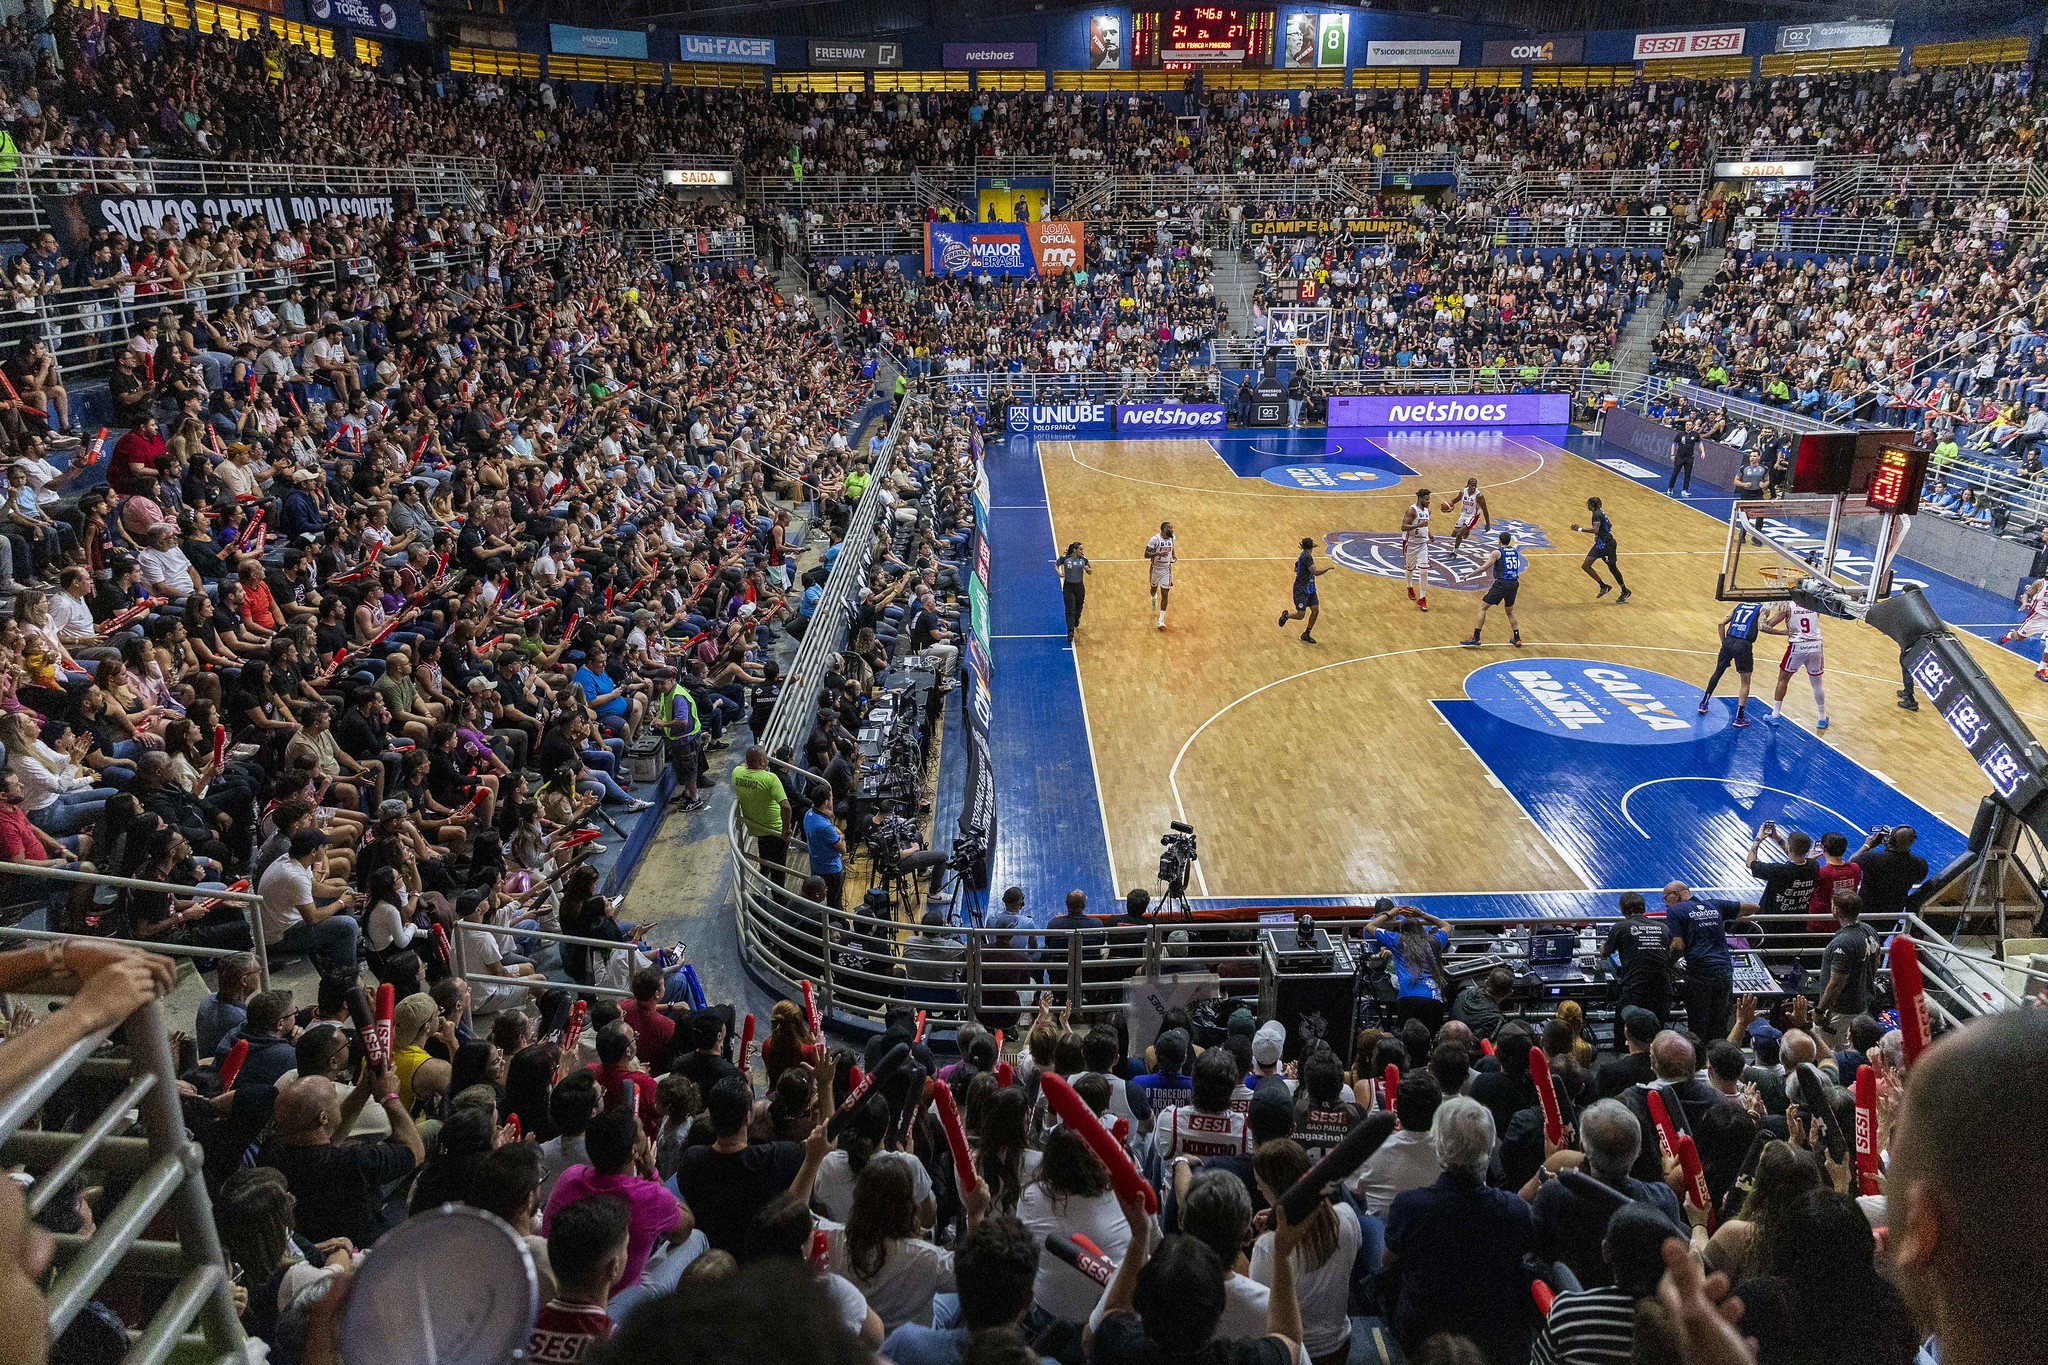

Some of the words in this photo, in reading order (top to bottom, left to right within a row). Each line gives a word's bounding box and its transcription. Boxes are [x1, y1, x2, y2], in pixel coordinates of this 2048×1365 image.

[335, 2, 369, 18] TORCE
[1174, 11, 1181, 20] 2
[1194, 8, 1222, 19] 7:46.8
[1231, 11, 1237, 19] 4
[1172, 25, 1187, 37] 24
[1228, 25, 1243, 37] 27
[1790, 32, 1803, 40] Q2
[1327, 30, 1340, 49] 8
[1643, 39, 1681, 53] SESI
[1695, 36, 1736, 50] SESI
[815, 47, 866, 58] FREEWAY
[966, 50, 1015, 60] netshoes
[101, 199, 198, 242] SOMOS
[1042, 224, 1070, 234] LOJA
[1040, 236, 1075, 244] OFICIAL
[973, 244, 1020, 256] MAIOR
[972, 259, 981, 267] do
[983, 256, 1024, 267] BRASIL
[1033, 405, 1105, 423] UNIUBE
[1123, 407, 1223, 426] netshoes
[1388, 401, 1507, 422] netshoes
[1505, 556, 1518, 570] 55
[1735, 609, 1753, 623] 17
[1800, 617, 1811, 633] 9
[1508, 671, 1605, 730] BRASIL
[1568, 681, 1600, 706] GOVERNO
[1597, 707, 1611, 716] DO
[1583, 668, 1692, 731] CAIXA
[1784, 888, 1814, 897] Temp
[362, 1026, 382, 1062] SESI
[845, 1073, 873, 1109] SESI
[1146, 1088, 1151, 1097] O
[1153, 1087, 1192, 1099] TORCEDOR
[1191, 1116, 1226, 1132] SESI
[1310, 1111, 1343, 1124] SESI
[1323, 1124, 1348, 1132] PAULO
[1857, 1108, 1870, 1153] SESI
[530, 1333, 584, 1360] SESI
